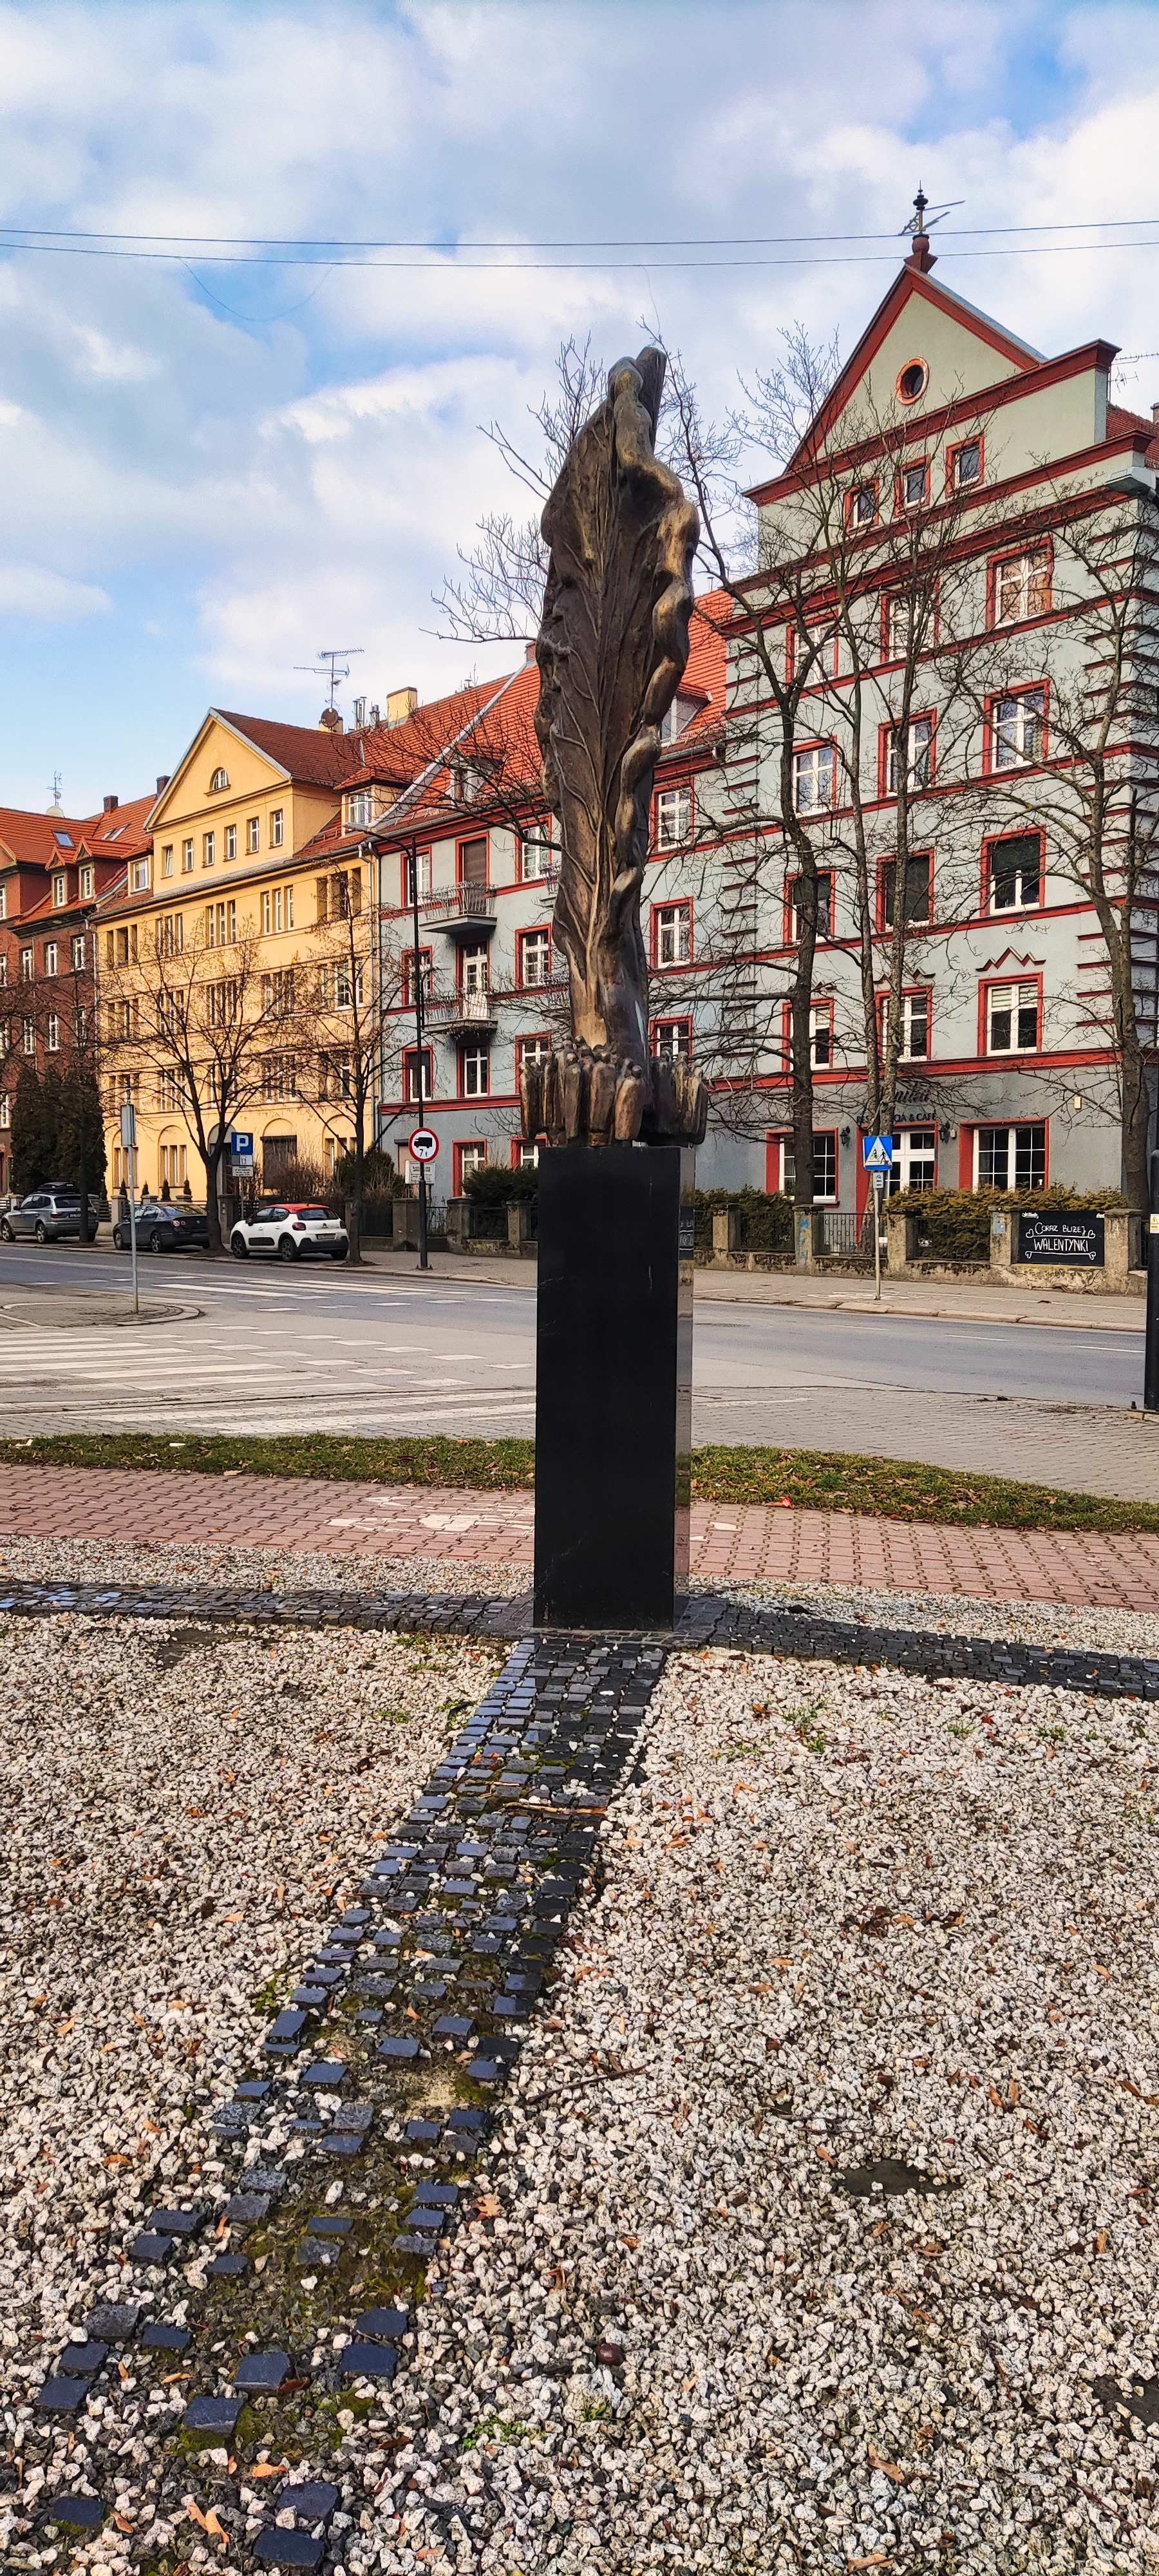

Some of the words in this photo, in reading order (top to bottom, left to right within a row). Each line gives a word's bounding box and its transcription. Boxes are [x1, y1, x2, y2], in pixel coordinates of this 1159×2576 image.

[909, 1113, 915, 1122] &
[236, 1135, 249, 1151] P
[1035, 1222, 1059, 1235] CORAZ
[1033, 1238, 1088, 1252] WALENTYNKI
